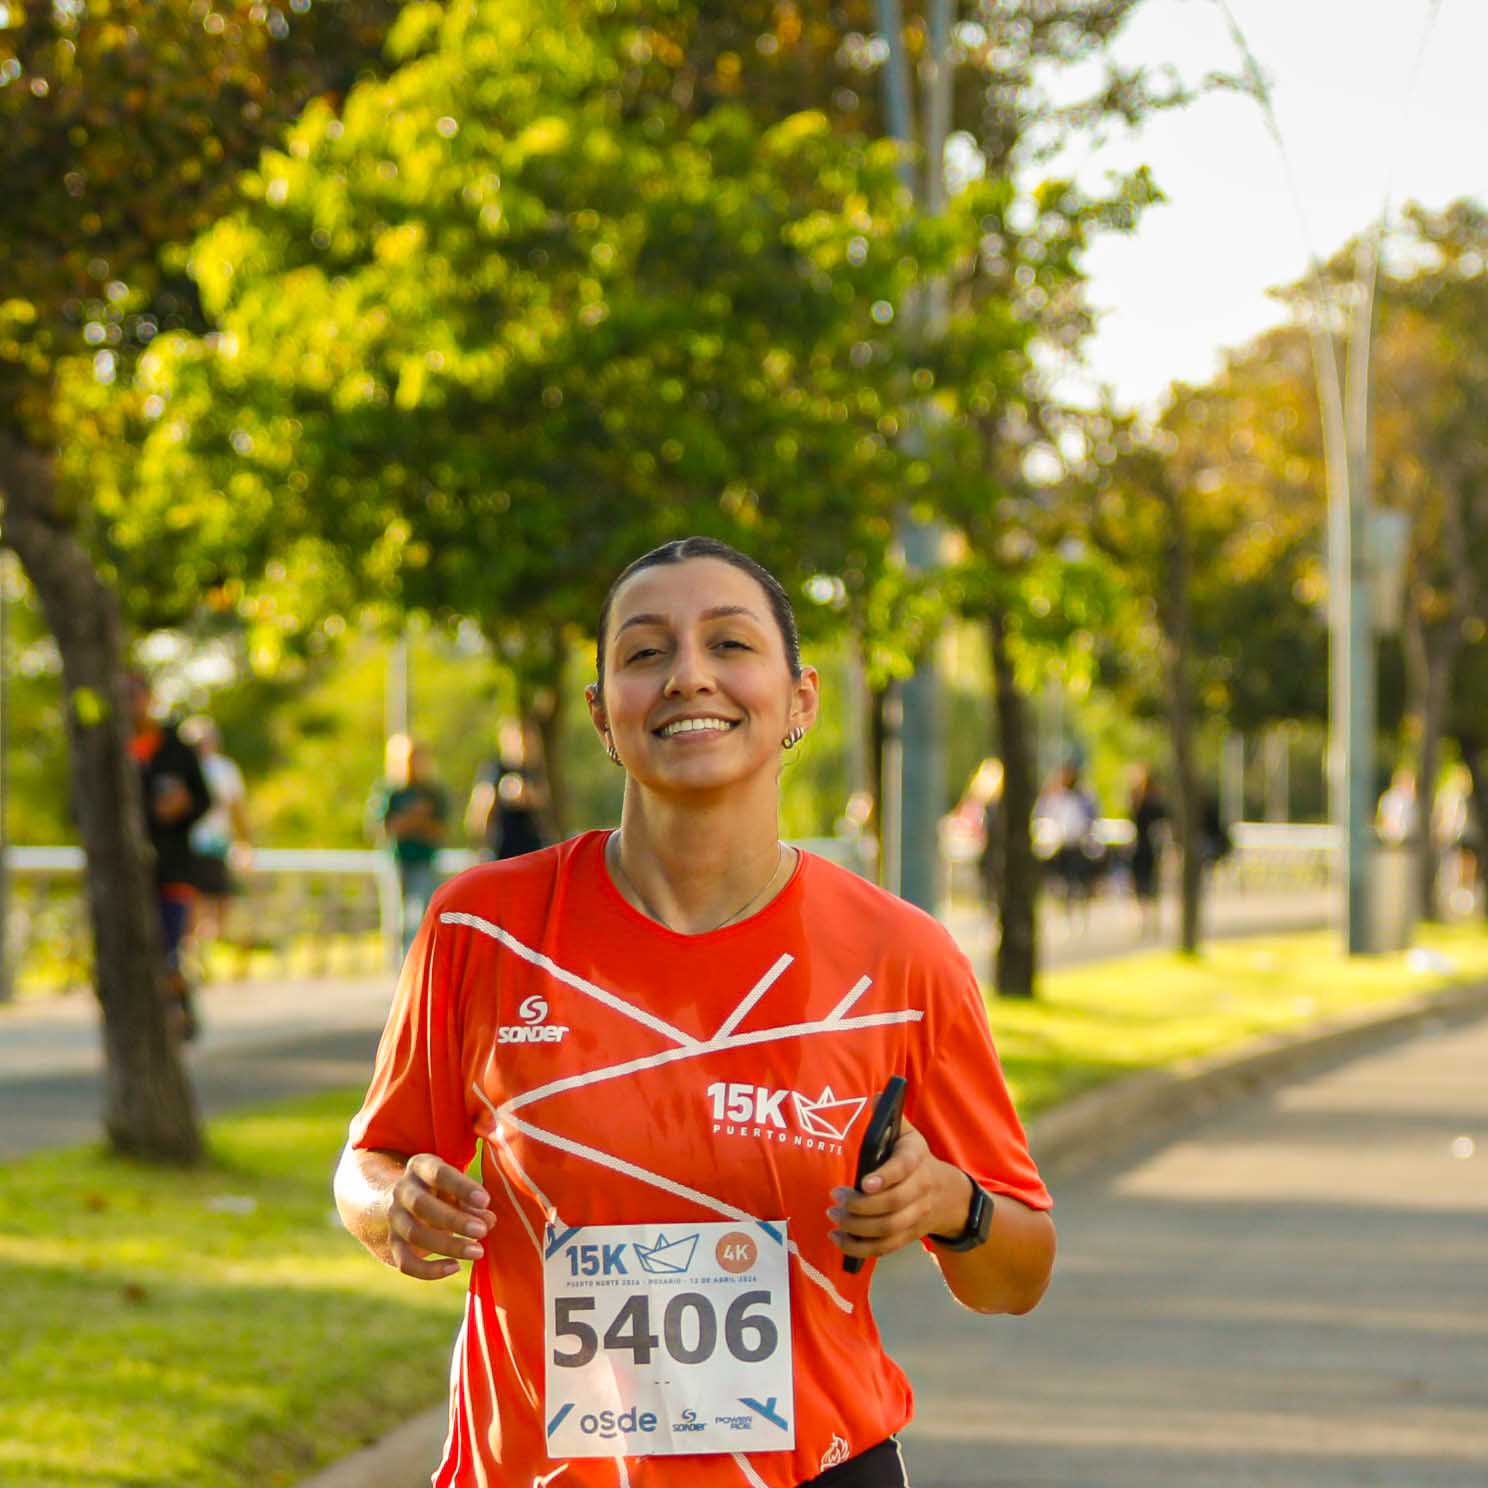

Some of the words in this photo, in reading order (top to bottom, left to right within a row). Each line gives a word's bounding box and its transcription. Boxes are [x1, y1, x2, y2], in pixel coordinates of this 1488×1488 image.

[707, 1082, 790, 1129] 15K
[713, 1124, 787, 1143] PUERTO
[565, 1243, 629, 1276] 15K
[723, 1244, 749, 1261] 4K
[553, 1290, 778, 1368] 5406
